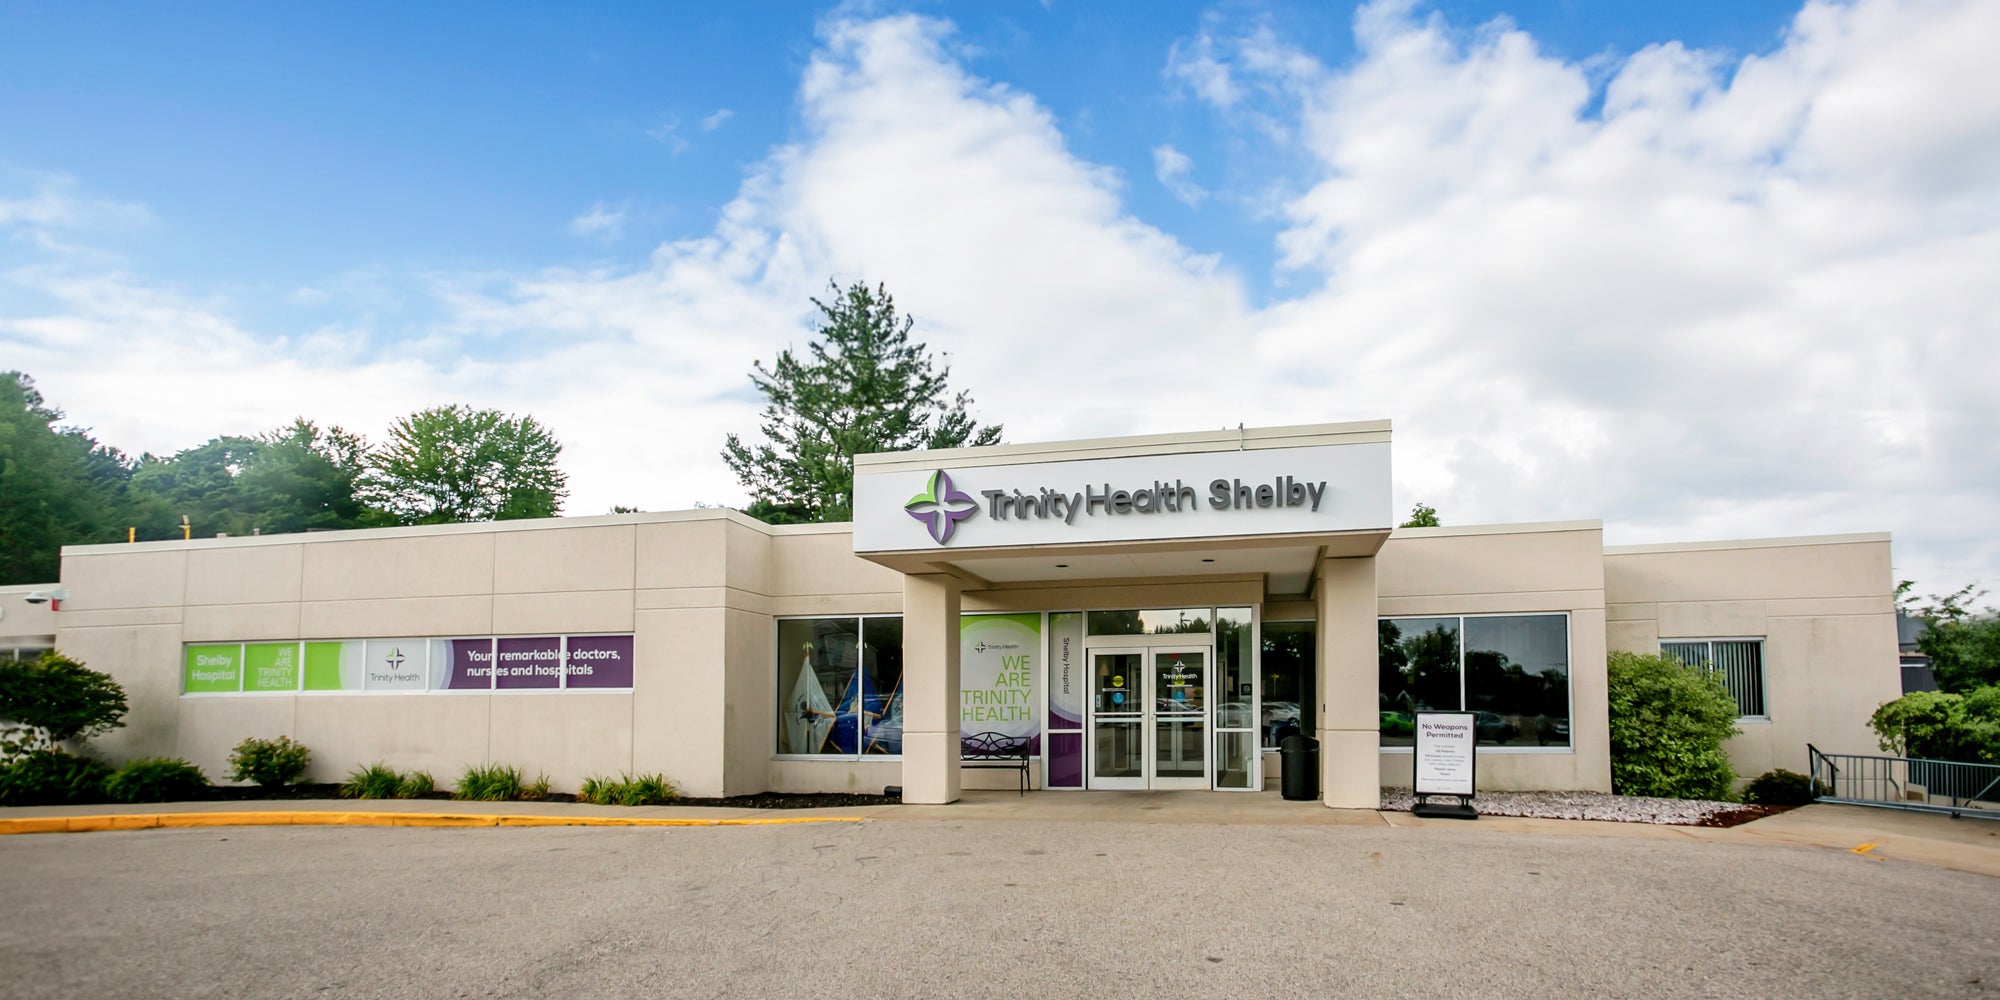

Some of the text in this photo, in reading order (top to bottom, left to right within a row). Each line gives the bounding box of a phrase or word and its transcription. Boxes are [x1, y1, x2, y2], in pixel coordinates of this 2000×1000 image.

[981, 475, 1327, 525] Trinity Health Shelby
[278, 647, 293, 657] WE
[467, 648, 621, 662] Your remarkable doctors,
[196, 654, 233, 668] Shelby
[275, 657, 293, 667] ARE
[1001, 655, 1031, 670] WE
[1062, 637, 1070, 694] Shelby Hospital
[191, 669, 236, 683] Hospital
[257, 667, 293, 677] TRINITY
[467, 663, 593, 678] nurses and hospitals
[257, 677, 293, 687] HEALTH
[370, 672, 420, 684] Trinity Health
[995, 672, 1031, 687] ARE
[961, 689, 1032, 704] TRINITY
[962, 706, 1031, 721] HEALTH
[1433, 723, 1468, 731] Weapons
[1426, 731, 1464, 739] Permitted
